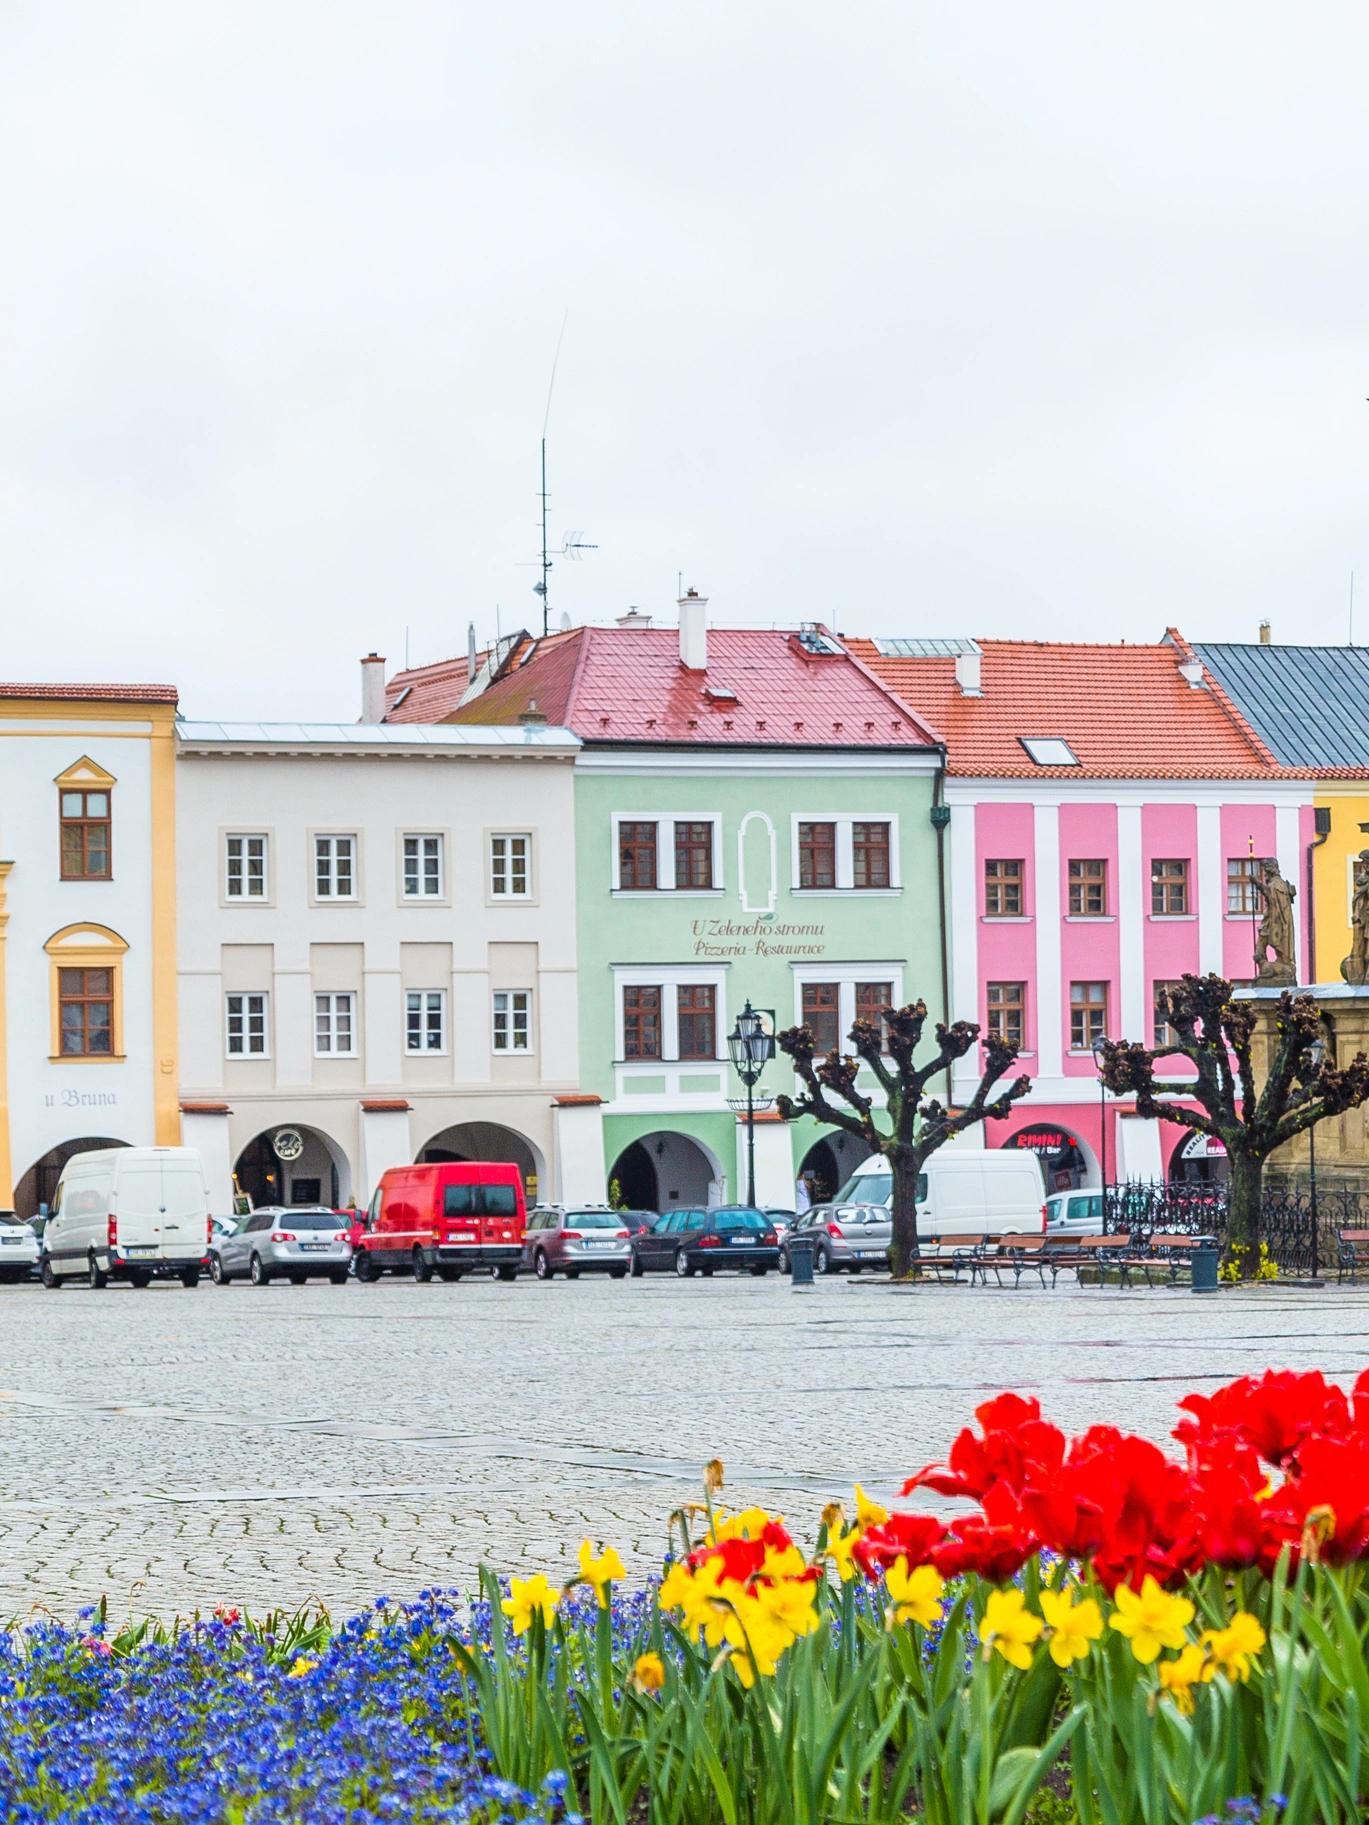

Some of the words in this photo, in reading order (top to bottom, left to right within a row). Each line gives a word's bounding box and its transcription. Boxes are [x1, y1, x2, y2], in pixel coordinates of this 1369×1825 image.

[774, 924, 825, 936] stromu
[44, 1094, 54, 1107] u
[61, 1089, 116, 1107] Bruna
[1016, 1133, 1063, 1147] RIMINI
[1046, 1146, 1061, 1154] Bar
